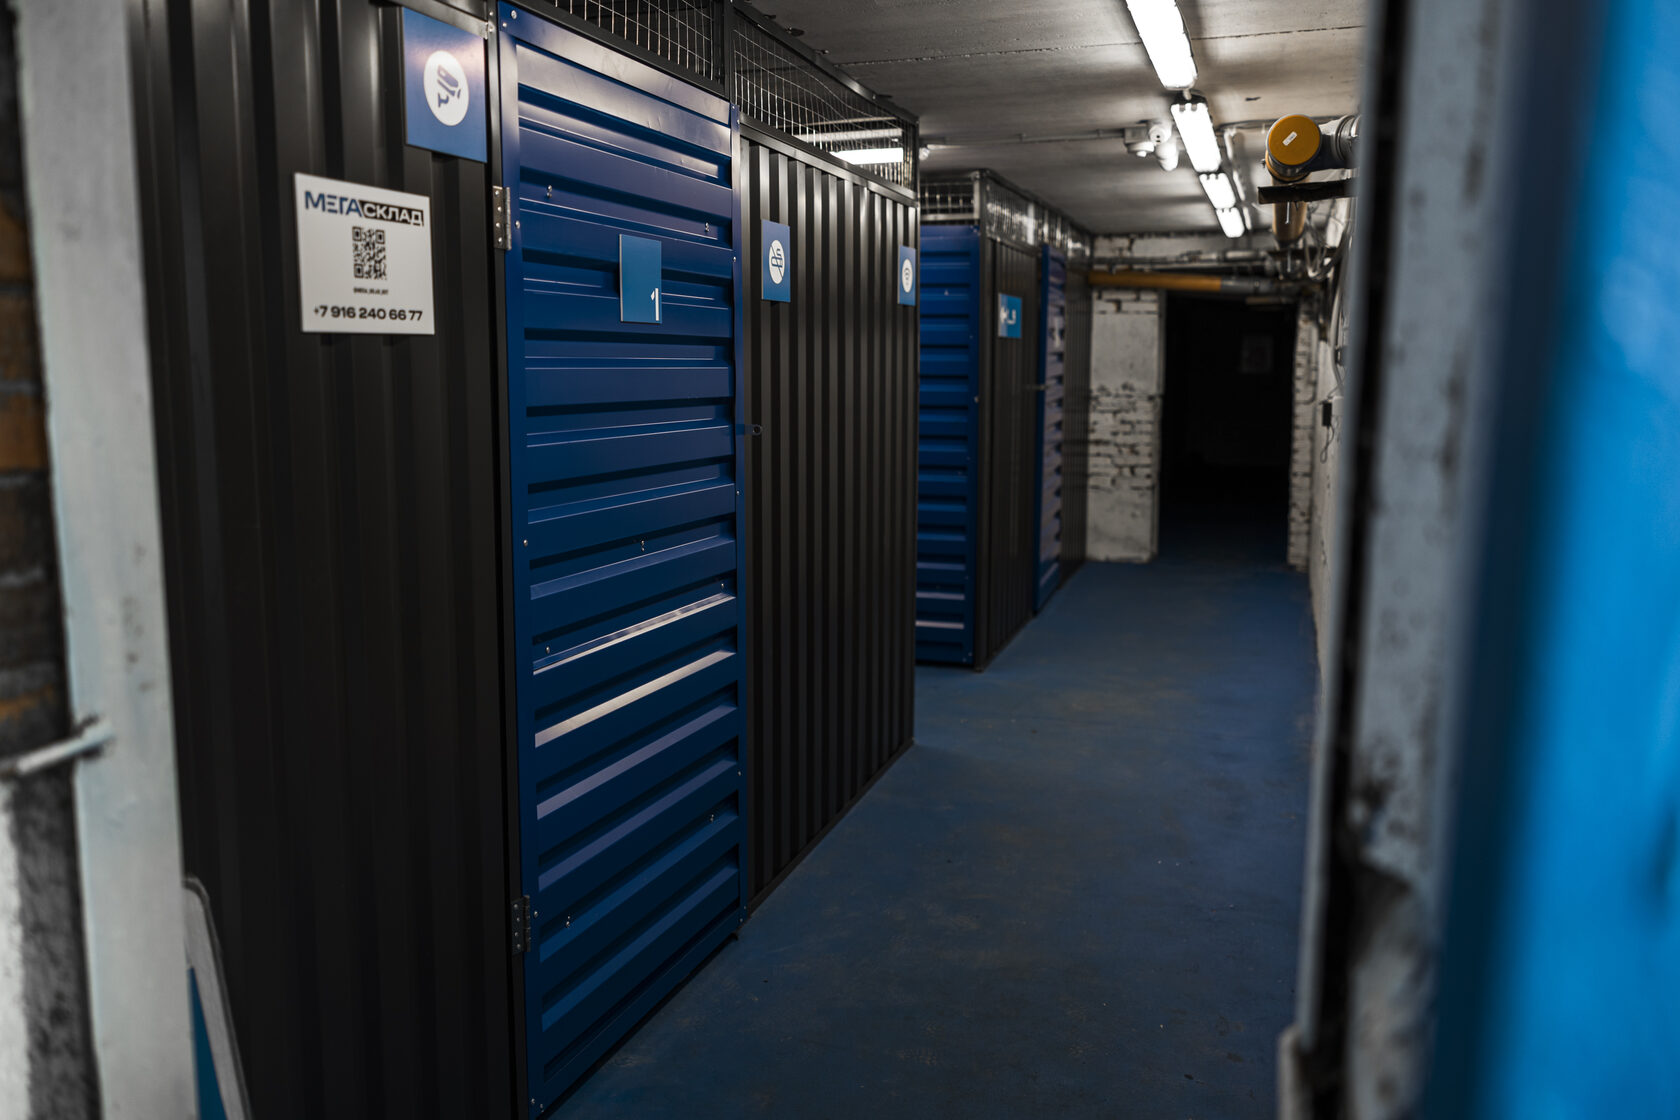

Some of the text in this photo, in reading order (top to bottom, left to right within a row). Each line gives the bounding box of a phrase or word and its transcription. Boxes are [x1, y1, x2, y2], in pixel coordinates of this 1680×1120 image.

[313, 305, 423, 321] +7 916 240 66 77
[650, 288, 659, 321] 1
